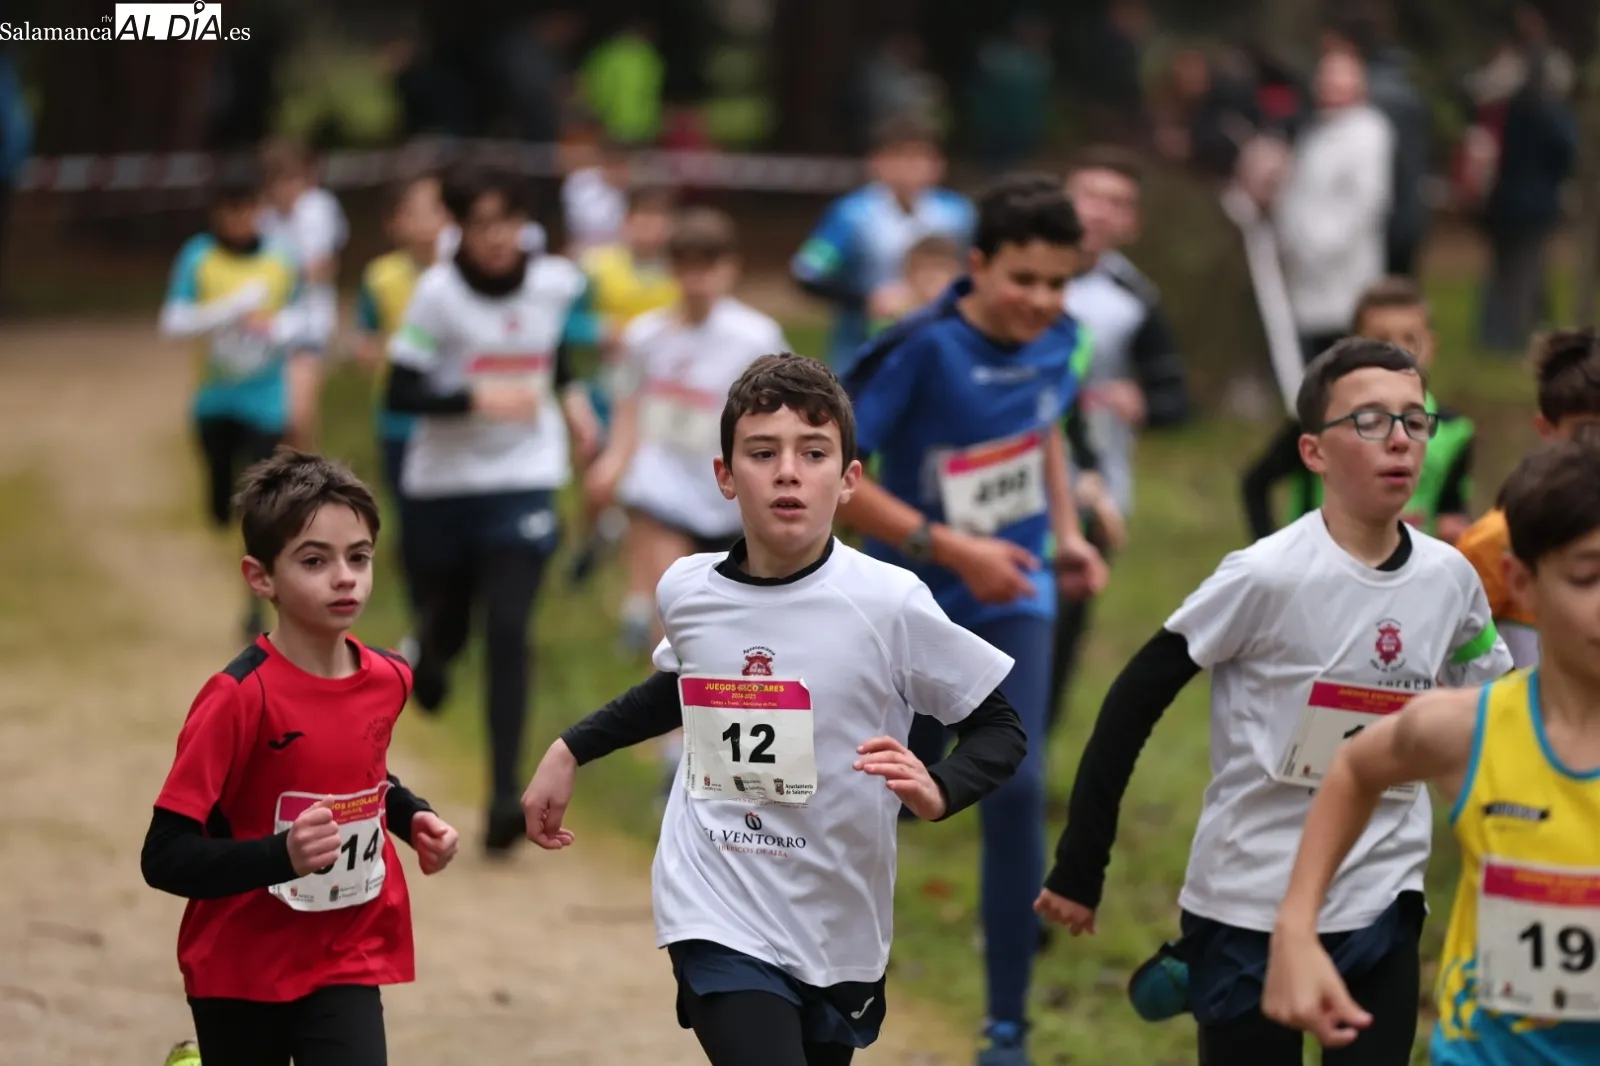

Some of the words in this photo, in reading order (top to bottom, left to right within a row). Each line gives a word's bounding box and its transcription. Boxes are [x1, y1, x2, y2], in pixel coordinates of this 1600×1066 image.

[705, 683, 736, 692] JUEGOS
[722, 723, 776, 764] 12
[312, 828, 380, 875] 14
[704, 827, 717, 842] L
[722, 829, 807, 849] VENTORRO
[1518, 919, 1597, 975] 19
